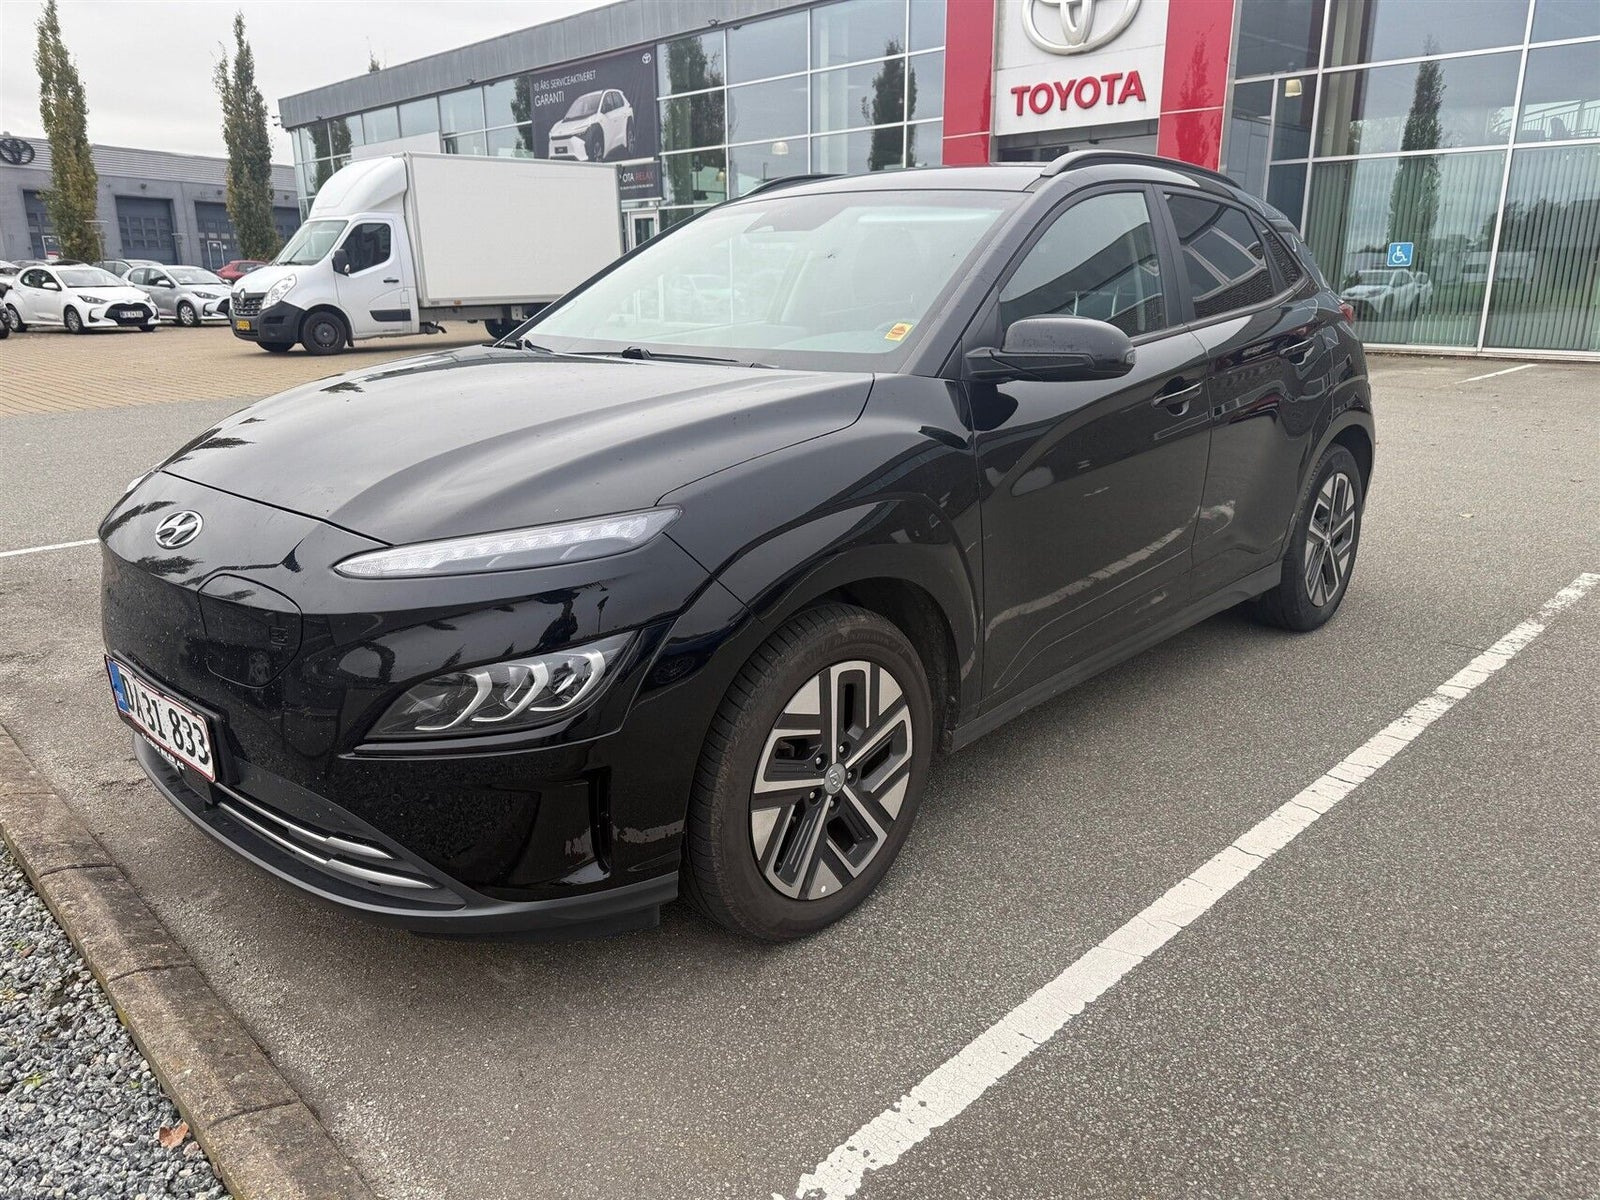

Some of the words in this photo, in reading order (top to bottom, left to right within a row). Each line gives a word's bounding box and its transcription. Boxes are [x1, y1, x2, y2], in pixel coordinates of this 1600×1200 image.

[534, 83, 540, 91] 10
[540, 79, 550, 90] ÅRS
[550, 70, 596, 88] SERVICEAKTIVERET
[534, 91, 565, 107] GARANTI
[1010, 70, 1147, 117] TOYOTA
[635, 170, 654, 181] RELAX
[168, 708, 210, 765] 833
